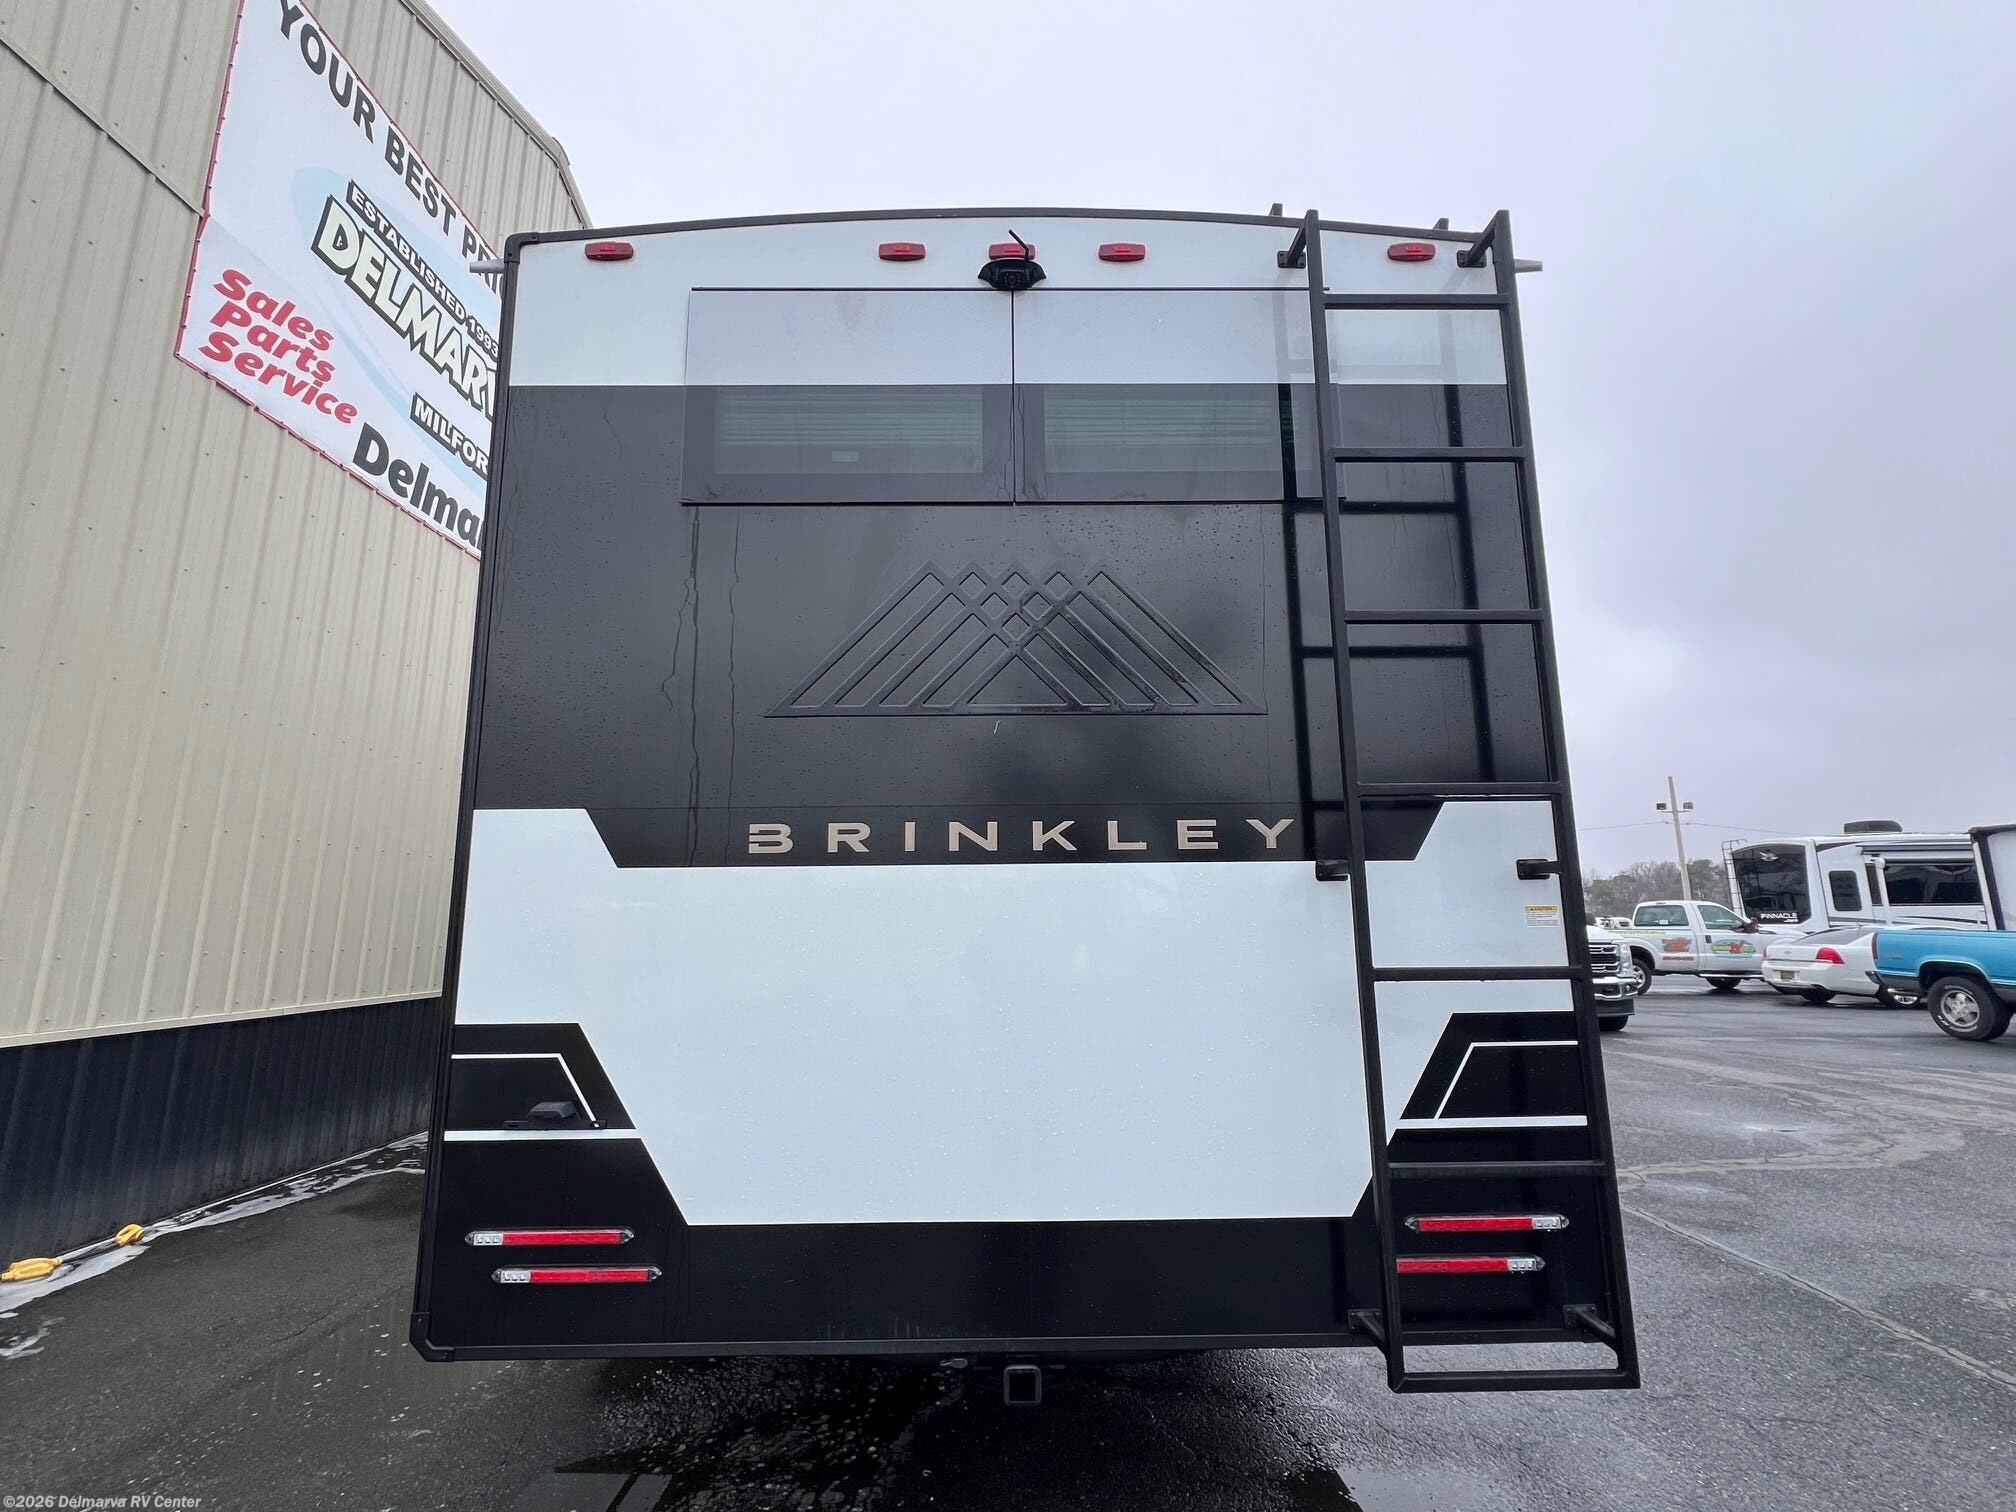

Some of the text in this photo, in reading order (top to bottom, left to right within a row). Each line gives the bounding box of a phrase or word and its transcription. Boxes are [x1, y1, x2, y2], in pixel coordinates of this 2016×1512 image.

[279, 0, 376, 143] YOUR
[384, 125, 456, 236] BEST
[212, 269, 334, 351] Sales
[347, 180, 499, 360] ESTABLISHED 1993
[198, 331, 358, 424] Service
[210, 300, 336, 382] Parts
[748, 818, 1295, 855] BRINKLEY
